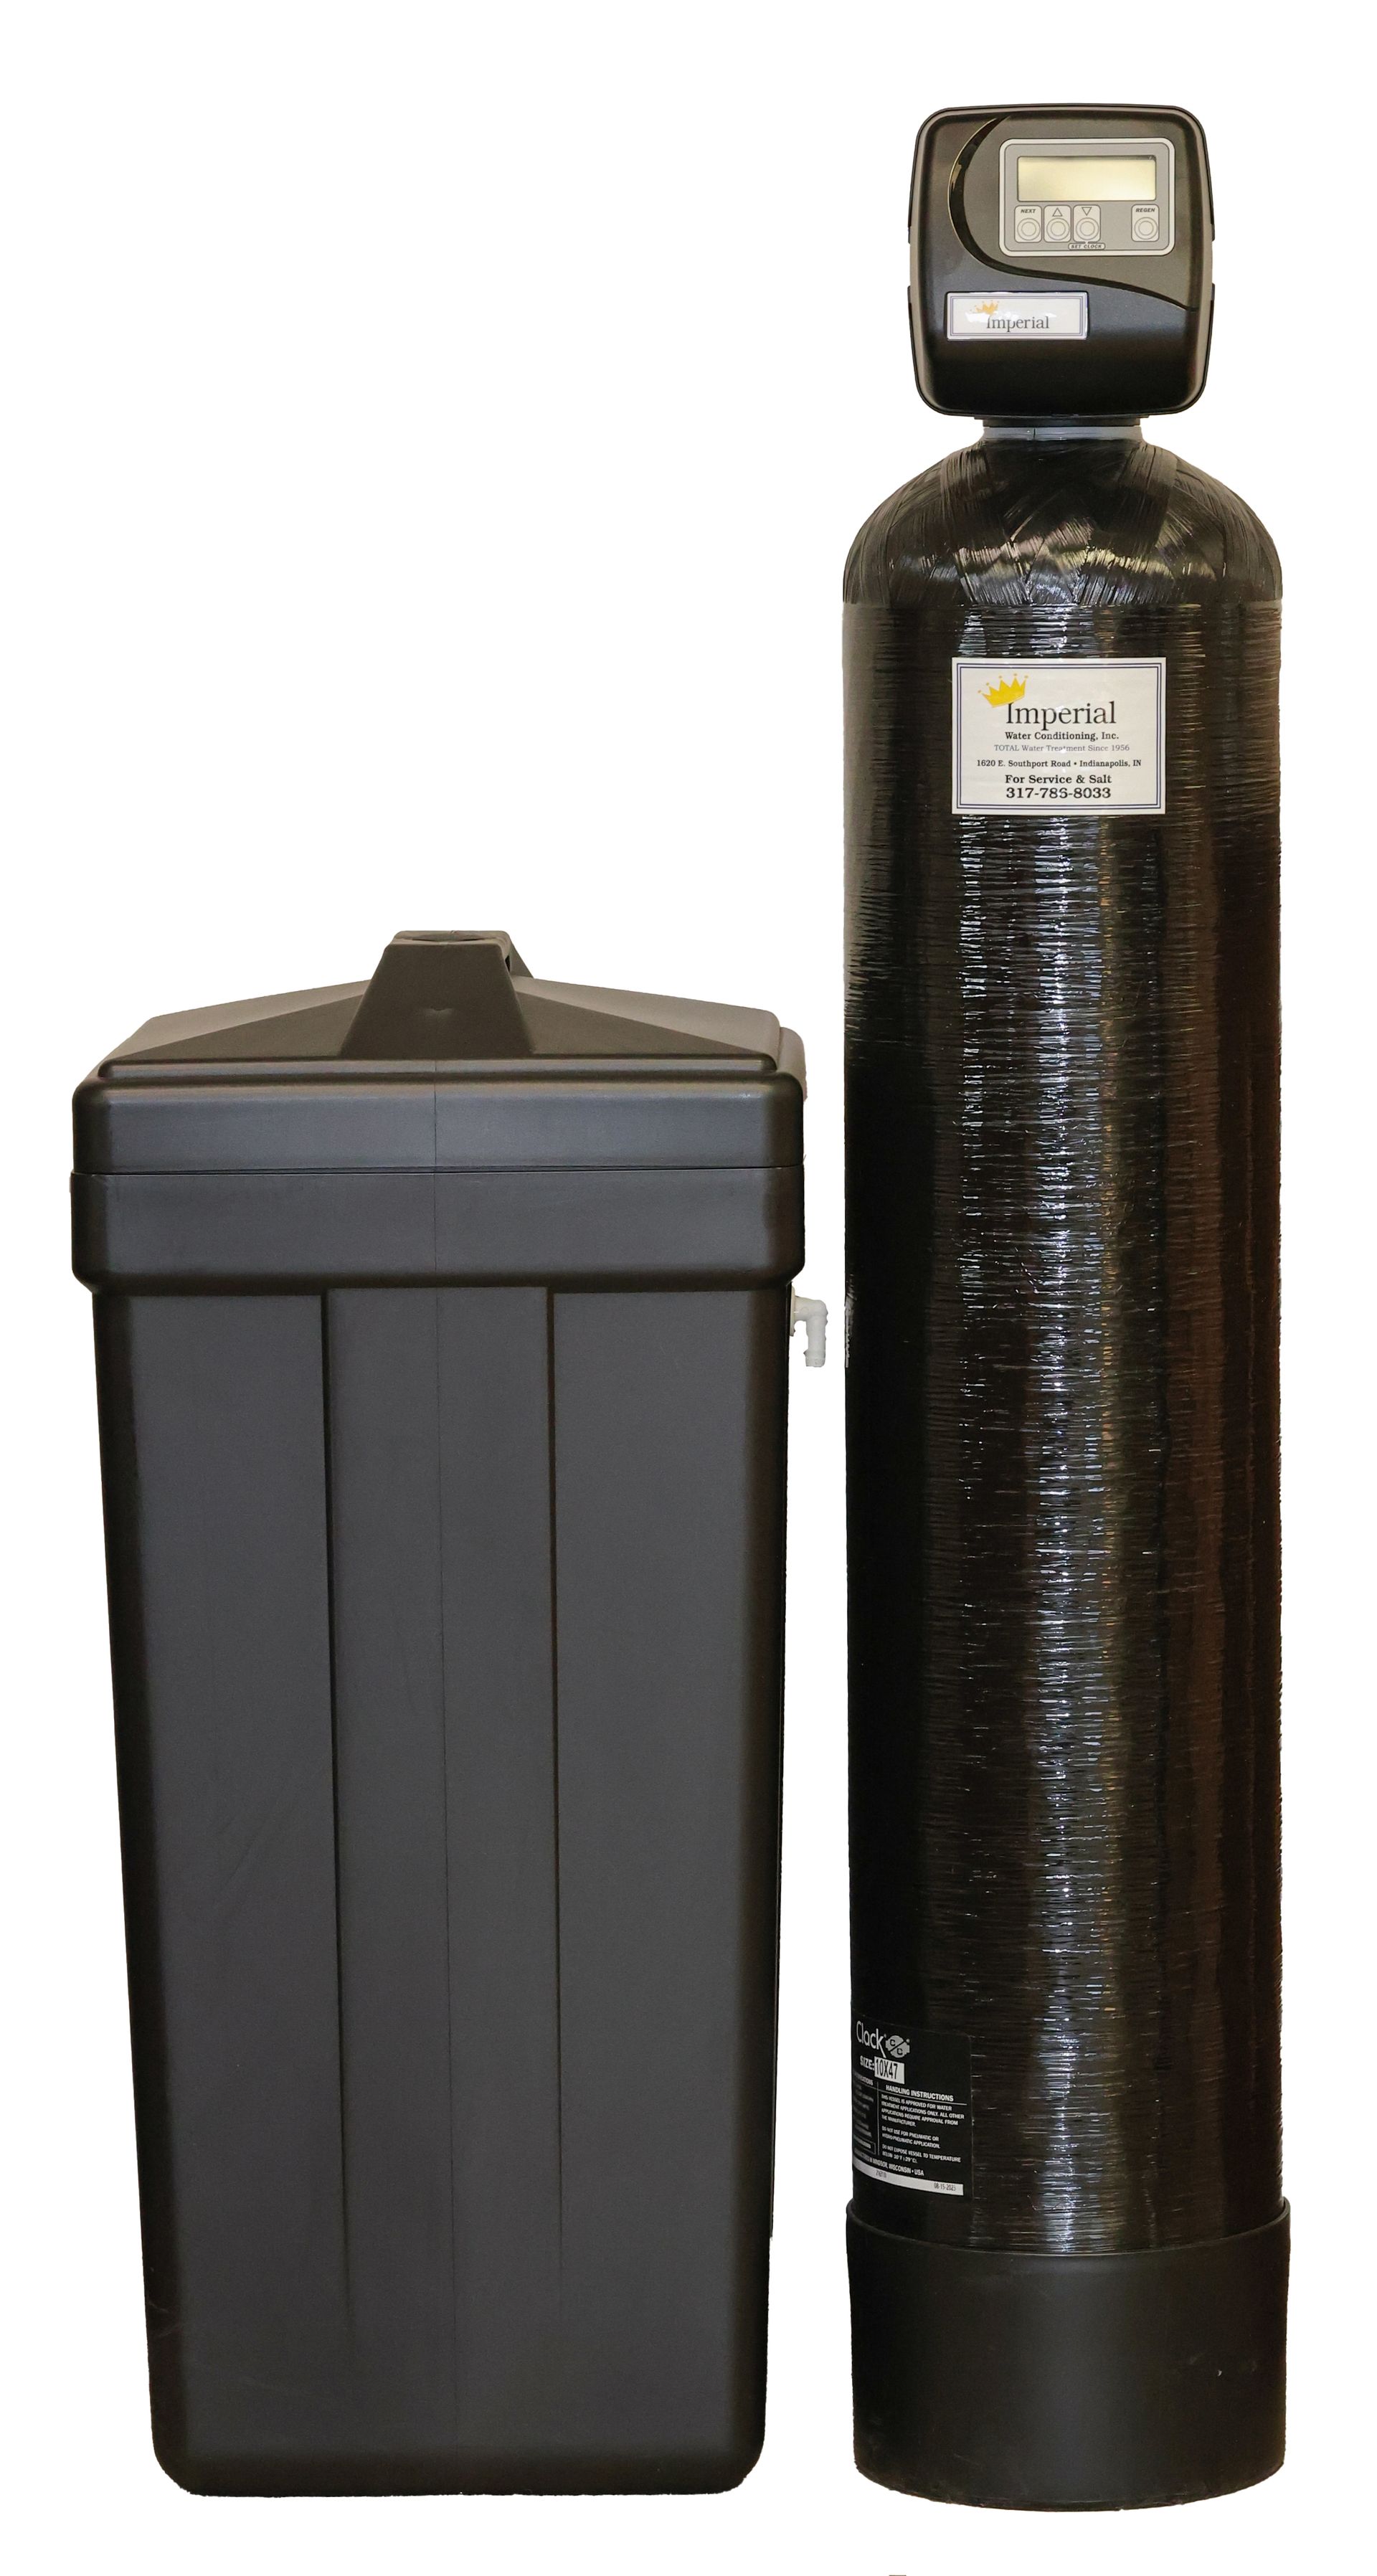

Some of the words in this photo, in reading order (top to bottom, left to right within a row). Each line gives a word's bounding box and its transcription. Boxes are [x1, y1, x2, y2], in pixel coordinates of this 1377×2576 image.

[986, 316, 1049, 333] Imperial
[1005, 701, 1117, 731] Imperial
[1005, 731, 1031, 740] Water
[1034, 731, 1099, 742] Conditioning,
[1101, 731, 1119, 740] Inc.
[1008, 759, 1048, 769] Southport
[1079, 759, 1130, 769] Indianapolis,
[1005, 775, 1025, 784] For
[1028, 775, 1072, 784] Service
[1076, 775, 1085, 784] &
[1089, 774, 1112, 784] Salt
[856, 2020, 886, 2058] Clack
[860, 2055, 875, 2070] SIZE:
[876, 2058, 898, 2080] 10X47
[886, 2084, 910, 2096] HANDLING
[911, 2090, 954, 2102] INSTRUCTIONS
[929, 2154, 961, 2163] TEMPERATURE
